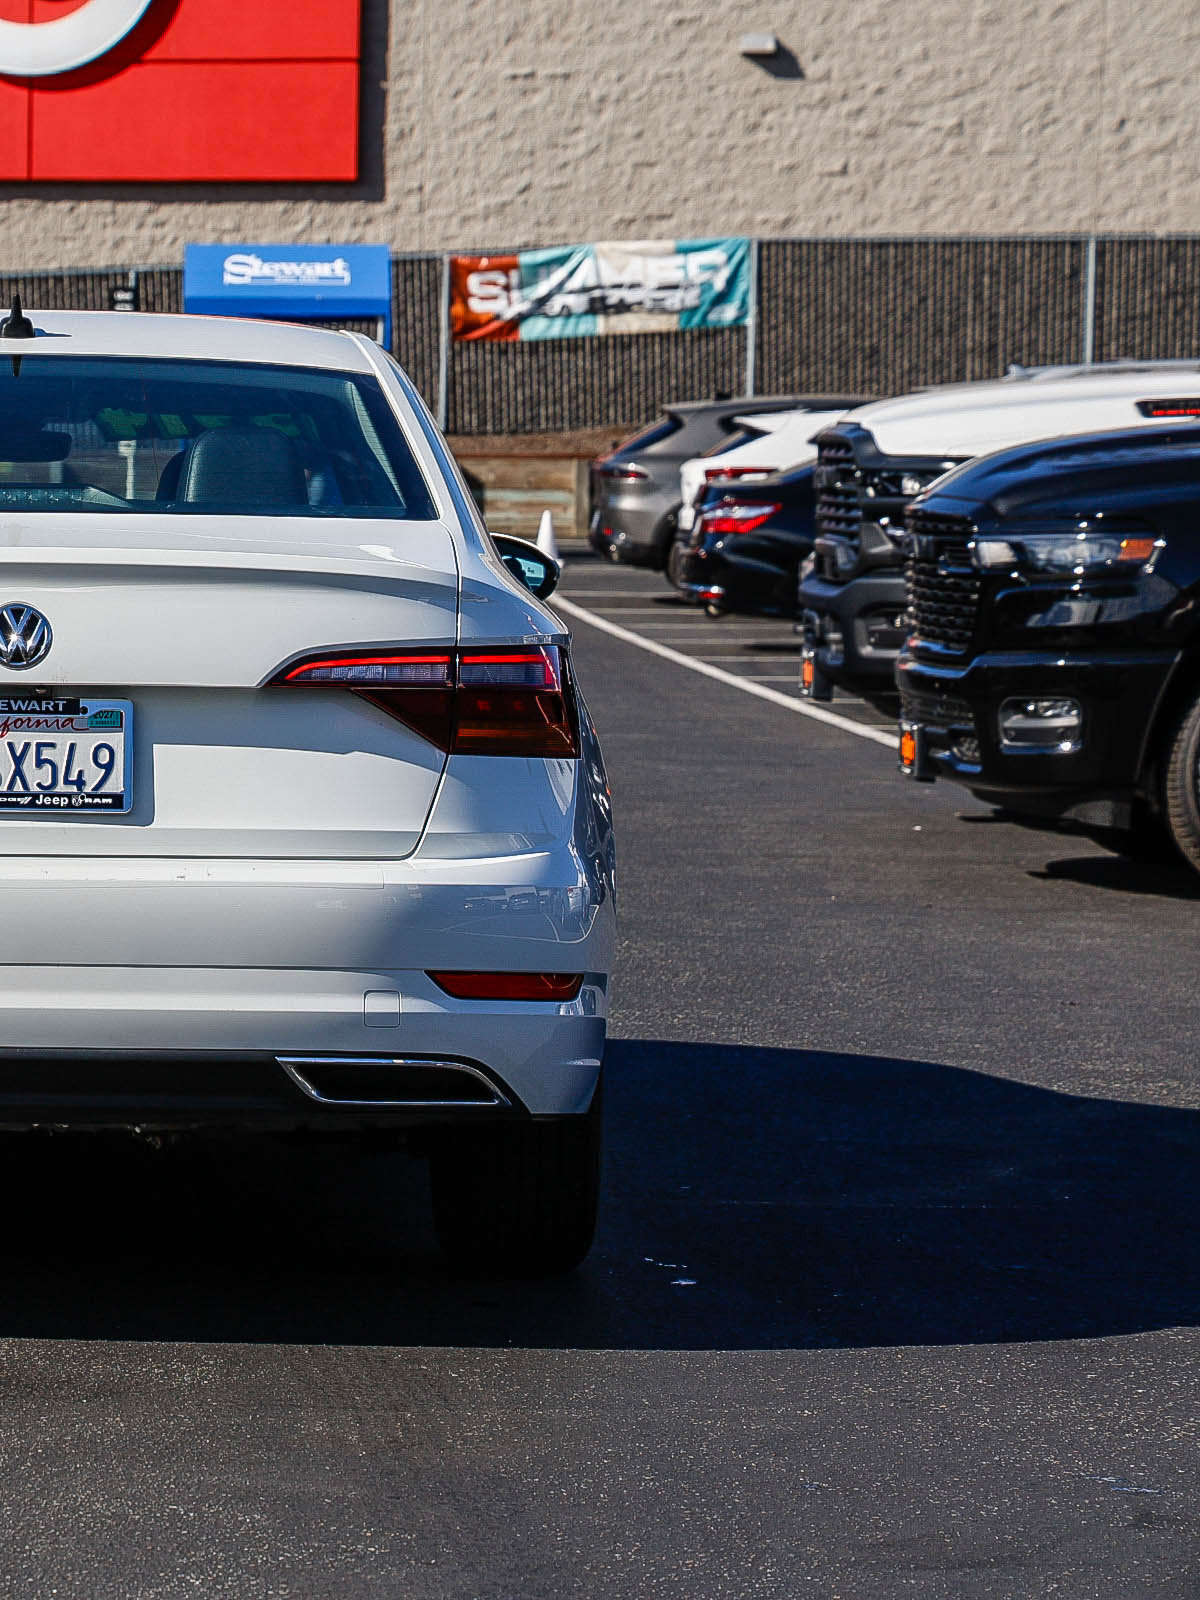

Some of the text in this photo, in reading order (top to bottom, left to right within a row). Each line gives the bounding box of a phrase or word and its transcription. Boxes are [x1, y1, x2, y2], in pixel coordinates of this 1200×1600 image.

[223, 254, 351, 286] Stewart
[466, 250, 728, 319] SMER
[36, 794, 69, 807] Jeep
